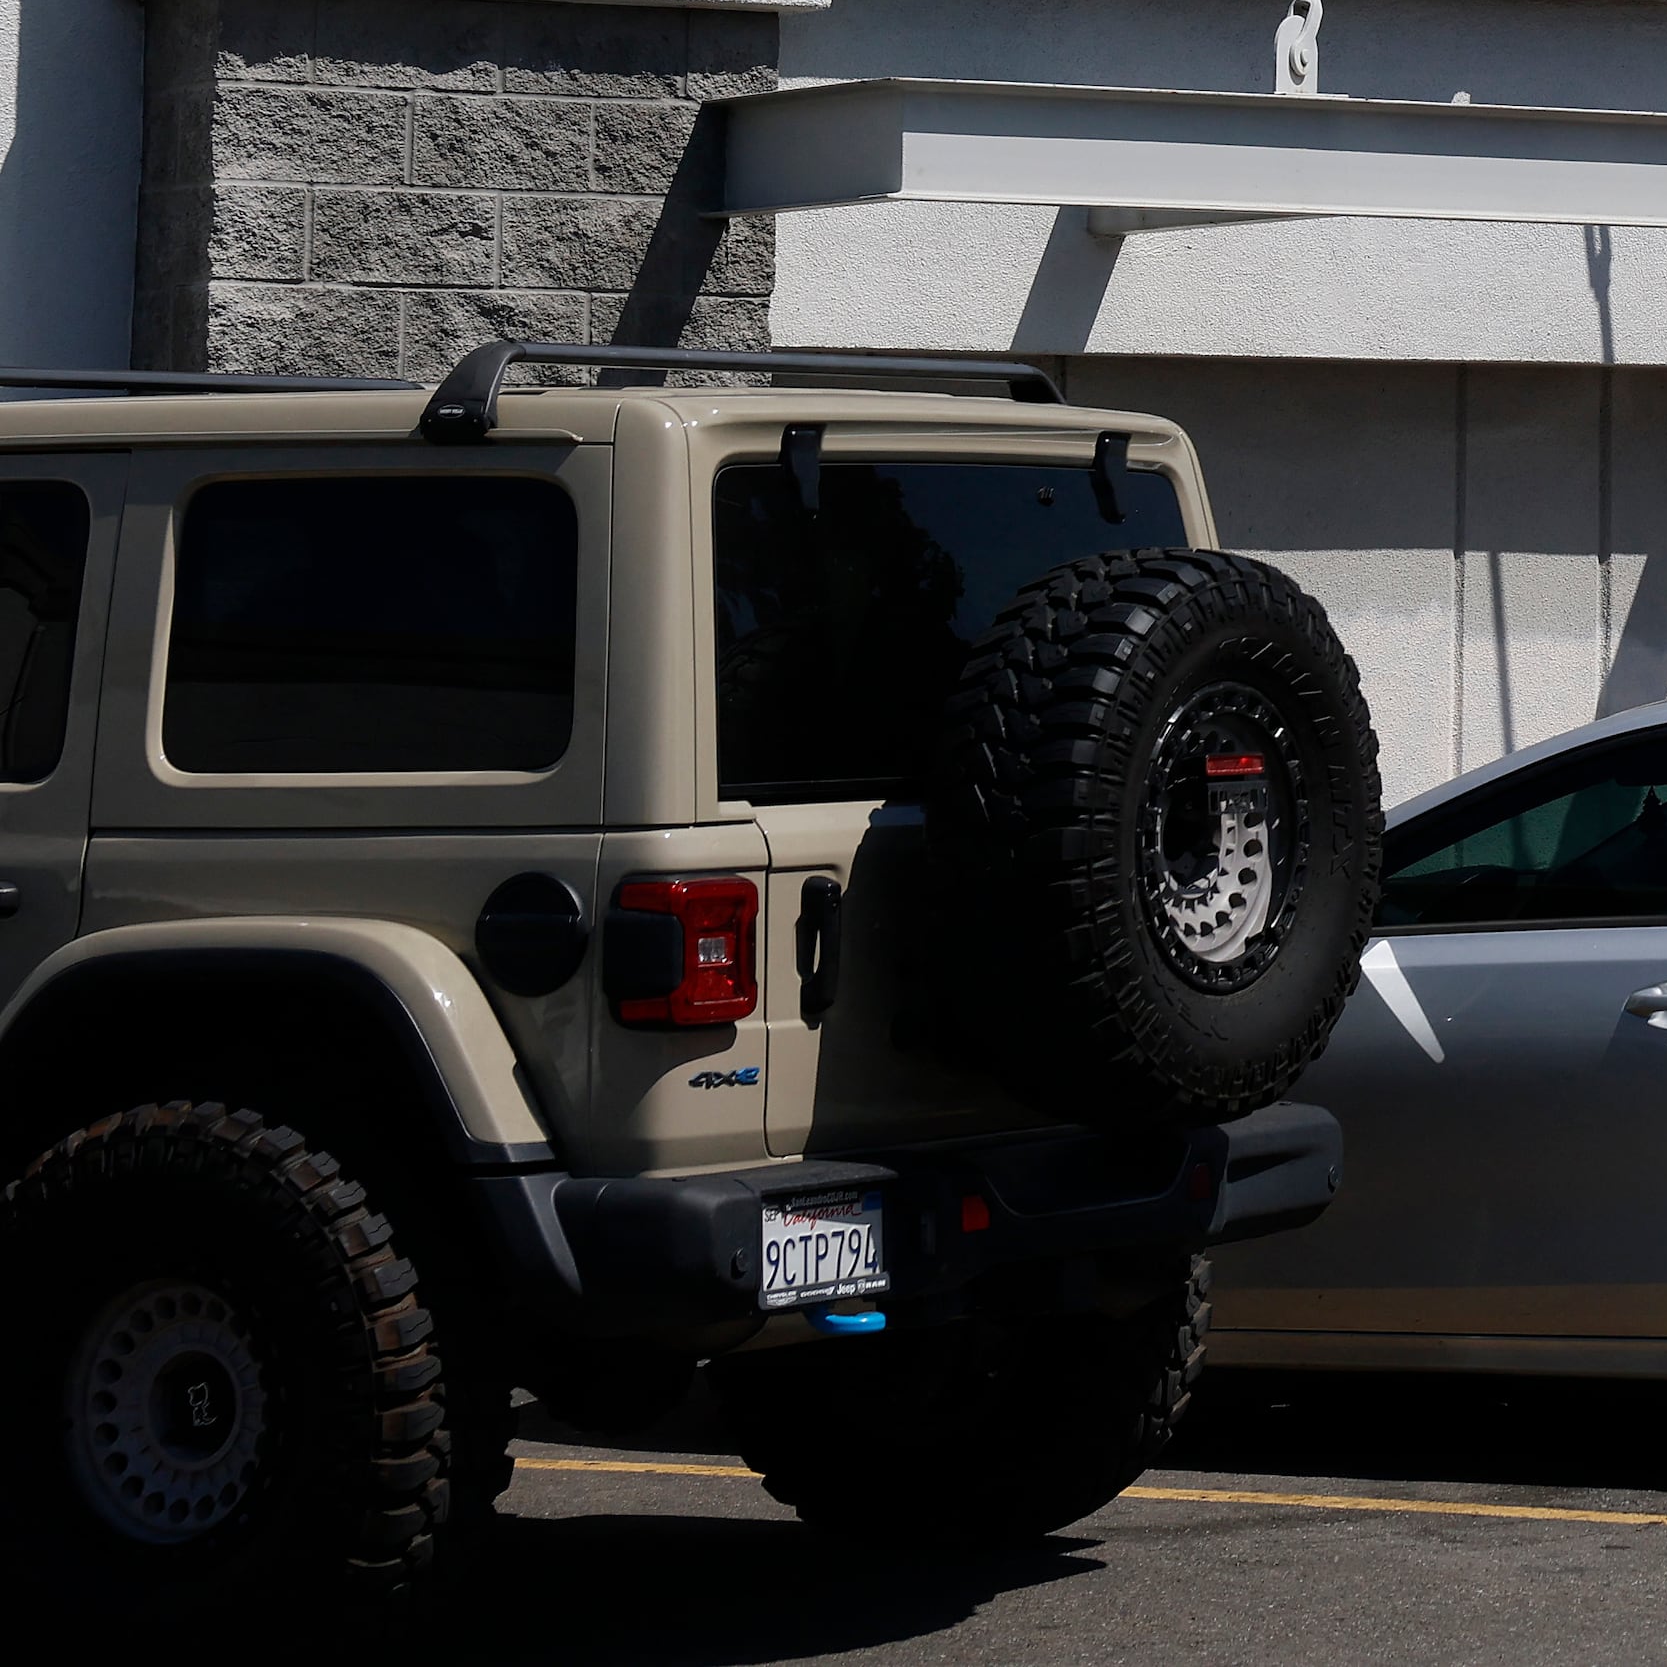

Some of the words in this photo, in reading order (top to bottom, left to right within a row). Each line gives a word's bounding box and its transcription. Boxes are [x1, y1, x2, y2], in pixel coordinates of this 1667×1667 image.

[782, 1203, 862, 1230] California
[766, 1224, 878, 1291] 9CTP794
[837, 1283, 856, 1295] Jeep
[865, 1280, 886, 1290] RAM
